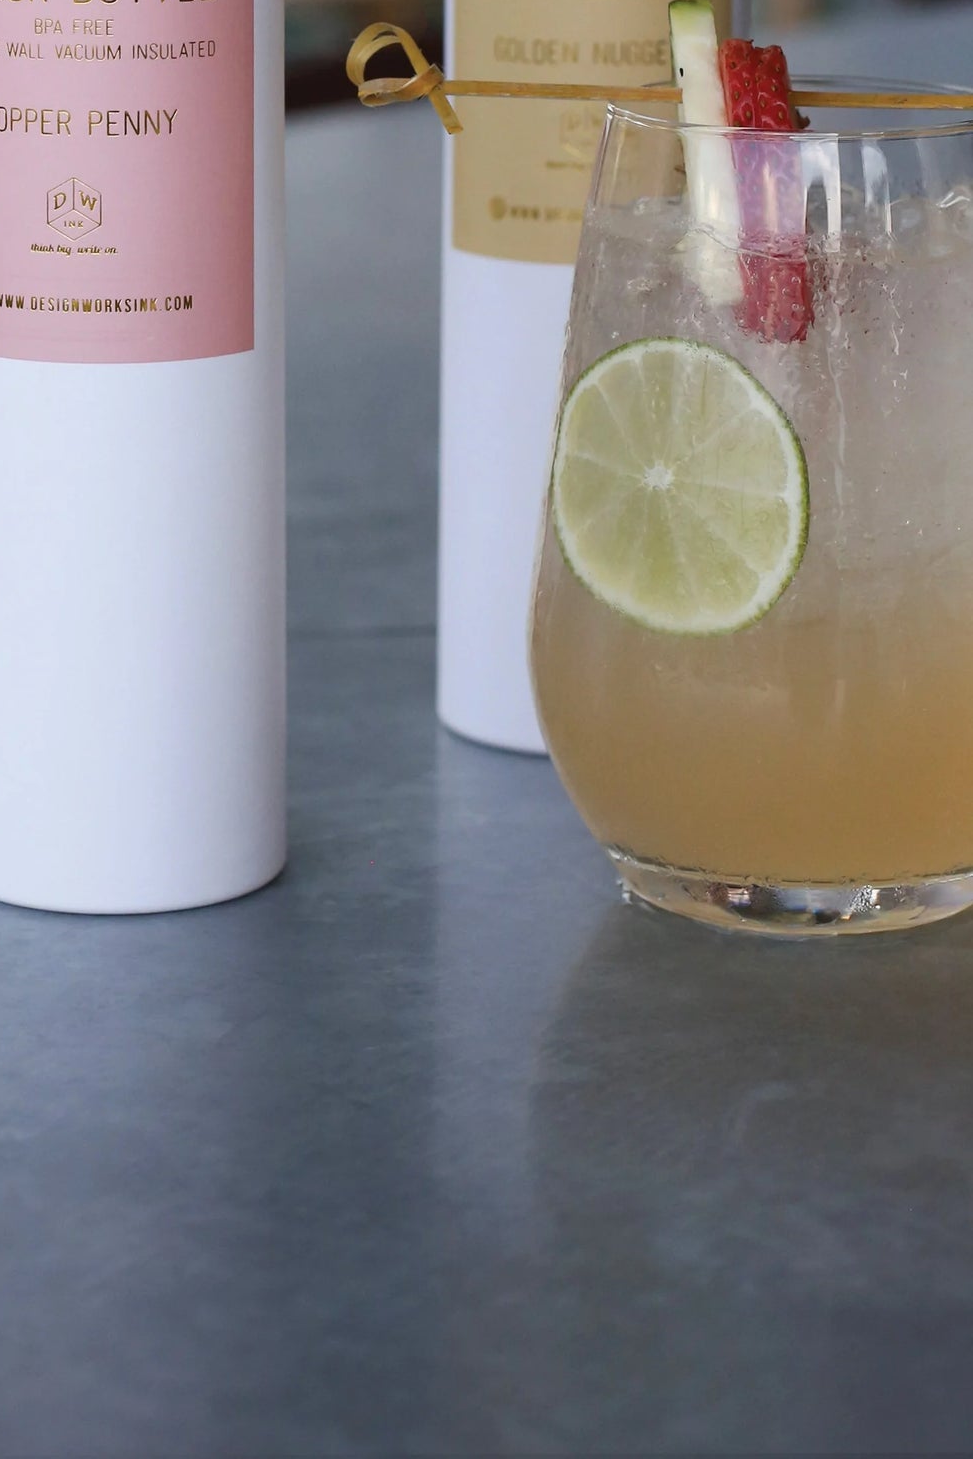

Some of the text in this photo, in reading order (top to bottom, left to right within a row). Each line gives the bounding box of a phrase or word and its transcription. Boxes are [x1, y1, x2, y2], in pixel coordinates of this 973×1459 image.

[34, 18, 115, 37] BPA FREE
[7, 41, 44, 60] WALL
[55, 44, 122, 61] VACUUM
[131, 40, 216, 60] INSULATED
[493, 36, 668, 66] GOLDEN NUGGE
[88, 108, 178, 137] PENNY
[53, 190, 98, 211] D W
[63, 220, 84, 228] INK
[30, 243, 55, 253] think
[76, 245, 101, 254] write
